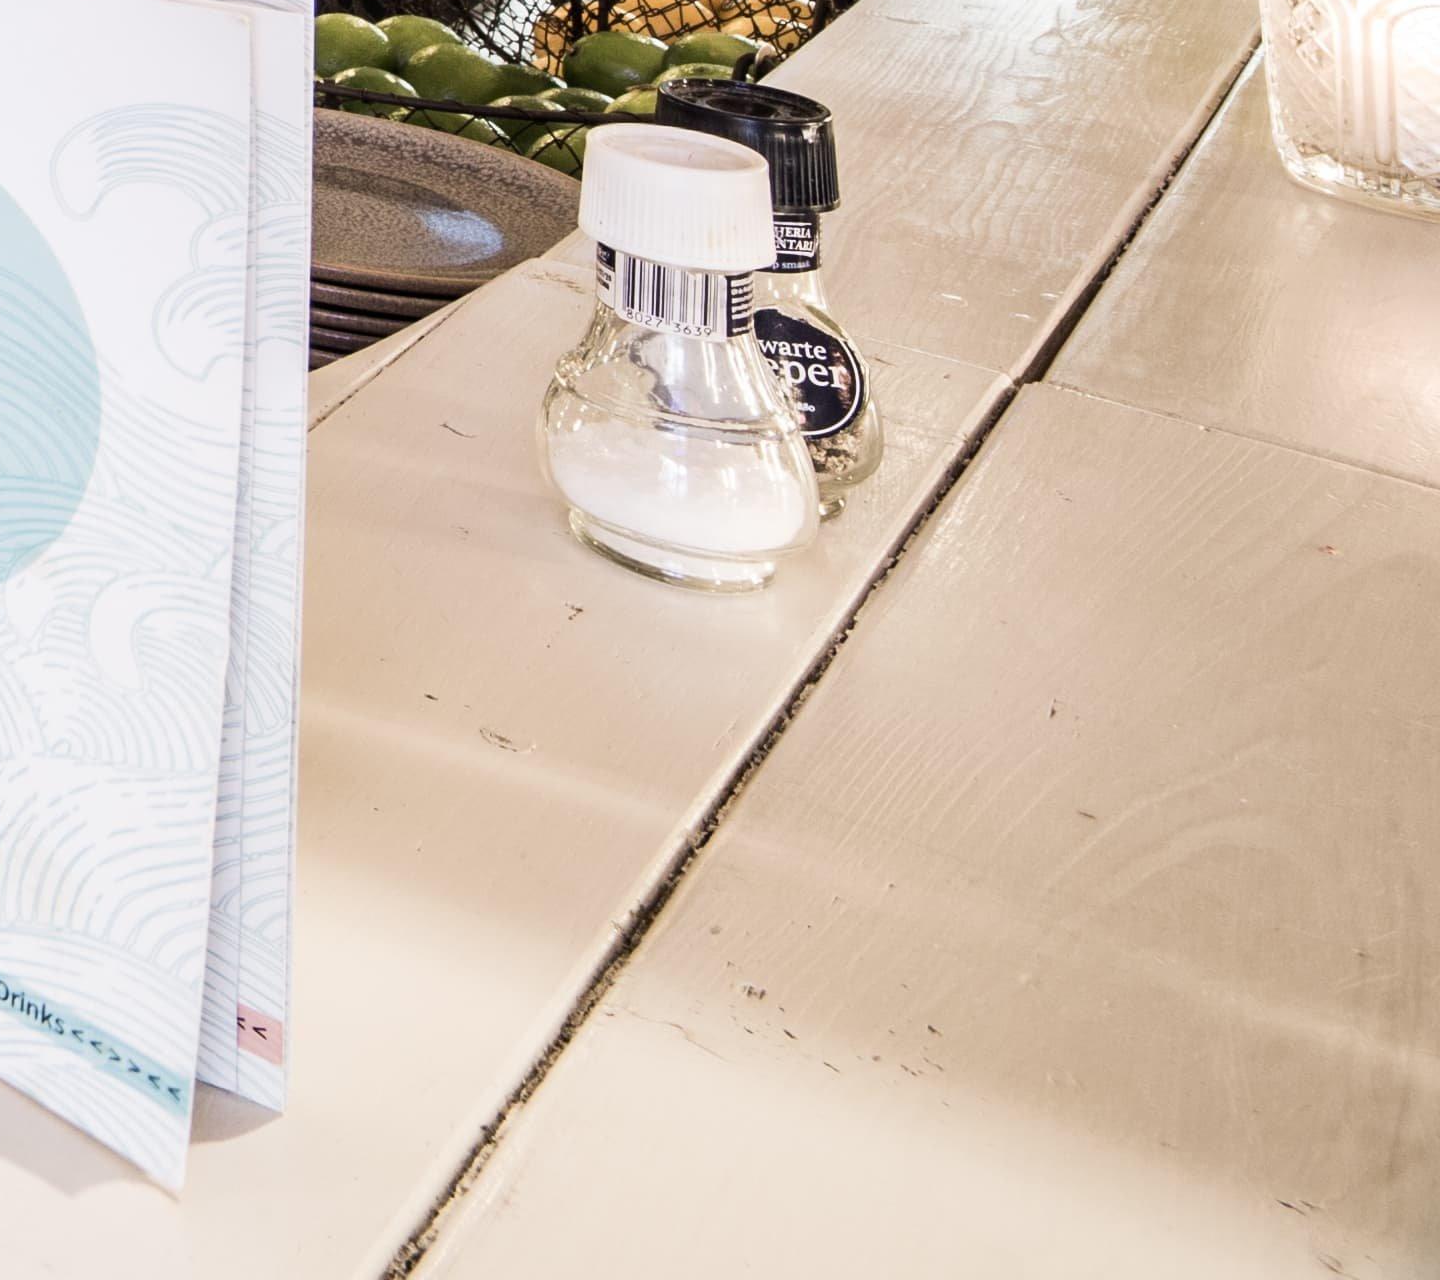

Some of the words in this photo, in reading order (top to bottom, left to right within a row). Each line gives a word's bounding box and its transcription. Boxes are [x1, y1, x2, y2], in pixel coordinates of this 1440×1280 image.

[774, 226, 812, 239] HERIA
[776, 239, 814, 252] NTARI
[626, 308, 664, 329] 8027
[674, 322, 713, 337] 3639
[758, 339, 828, 361] warte
